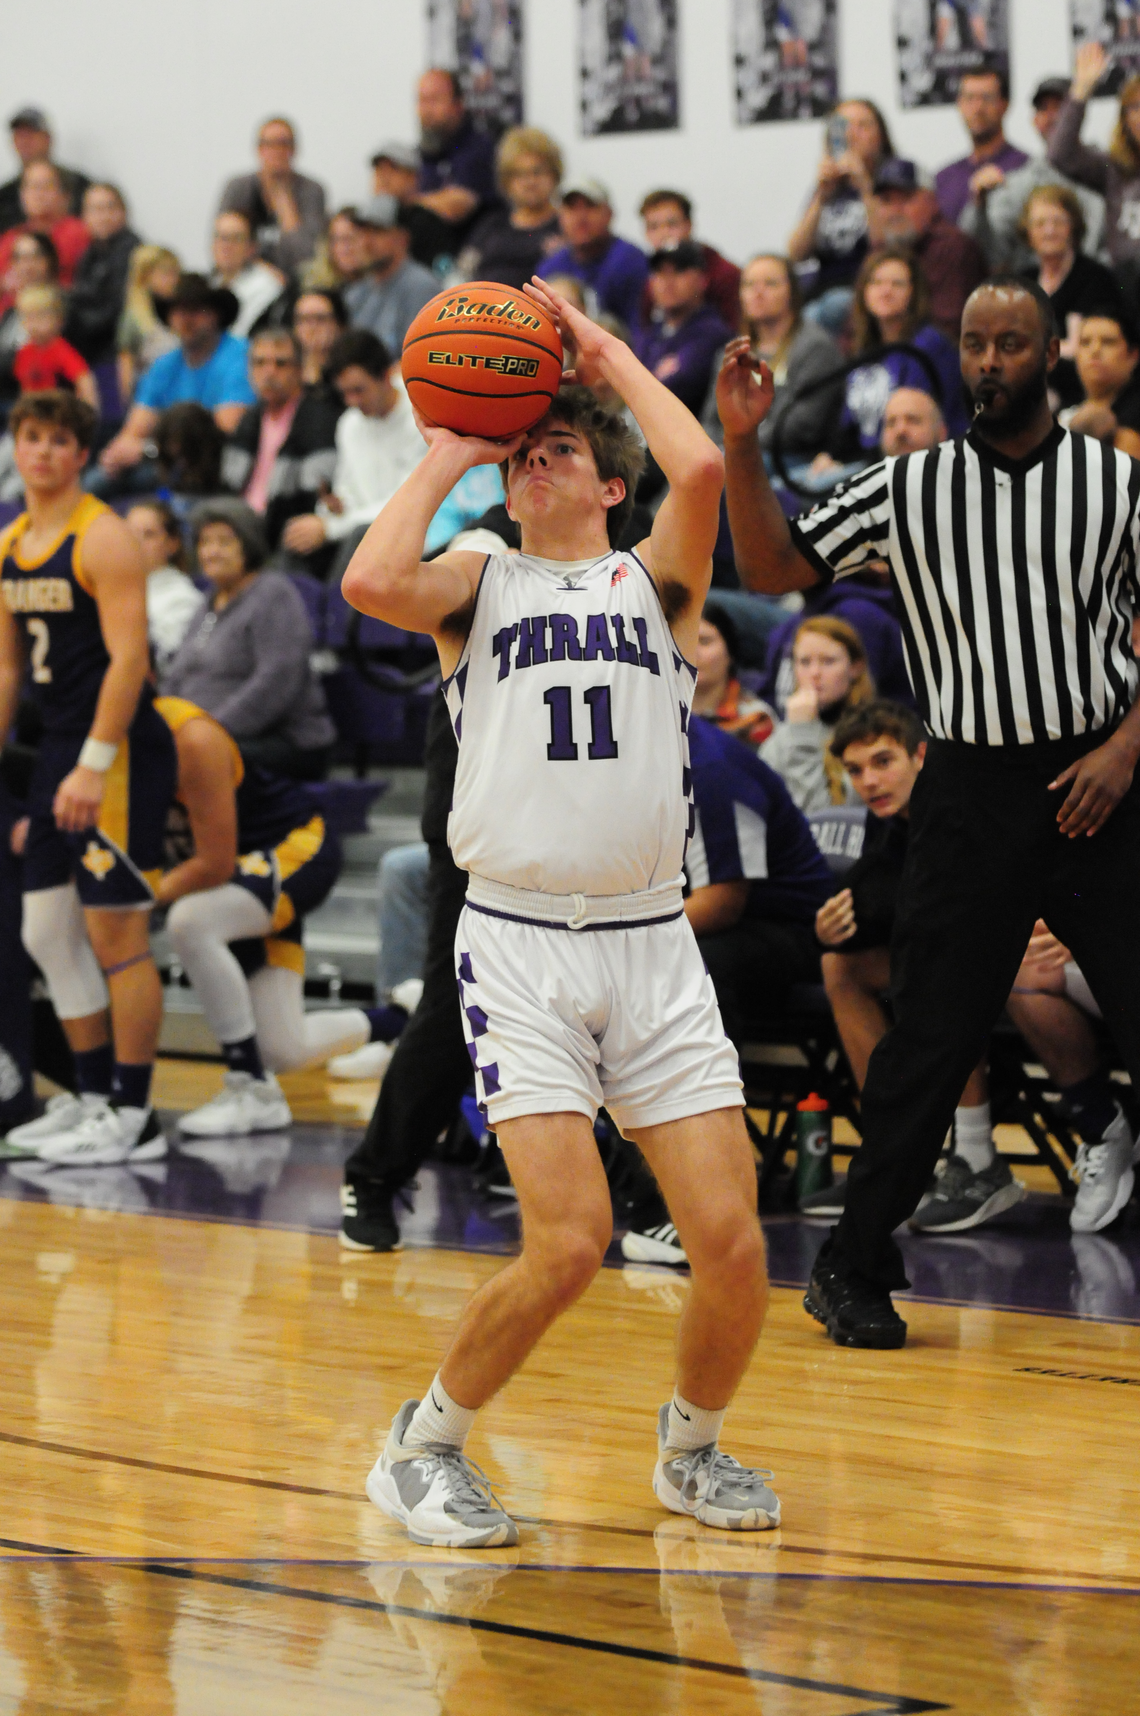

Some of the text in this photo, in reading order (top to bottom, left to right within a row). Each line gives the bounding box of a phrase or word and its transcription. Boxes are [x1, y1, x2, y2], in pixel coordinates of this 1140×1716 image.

[436, 297, 541, 330] Baden
[26, 618, 52, 683] 2
[492, 613, 661, 683] THRALL
[543, 685, 618, 761] 11
